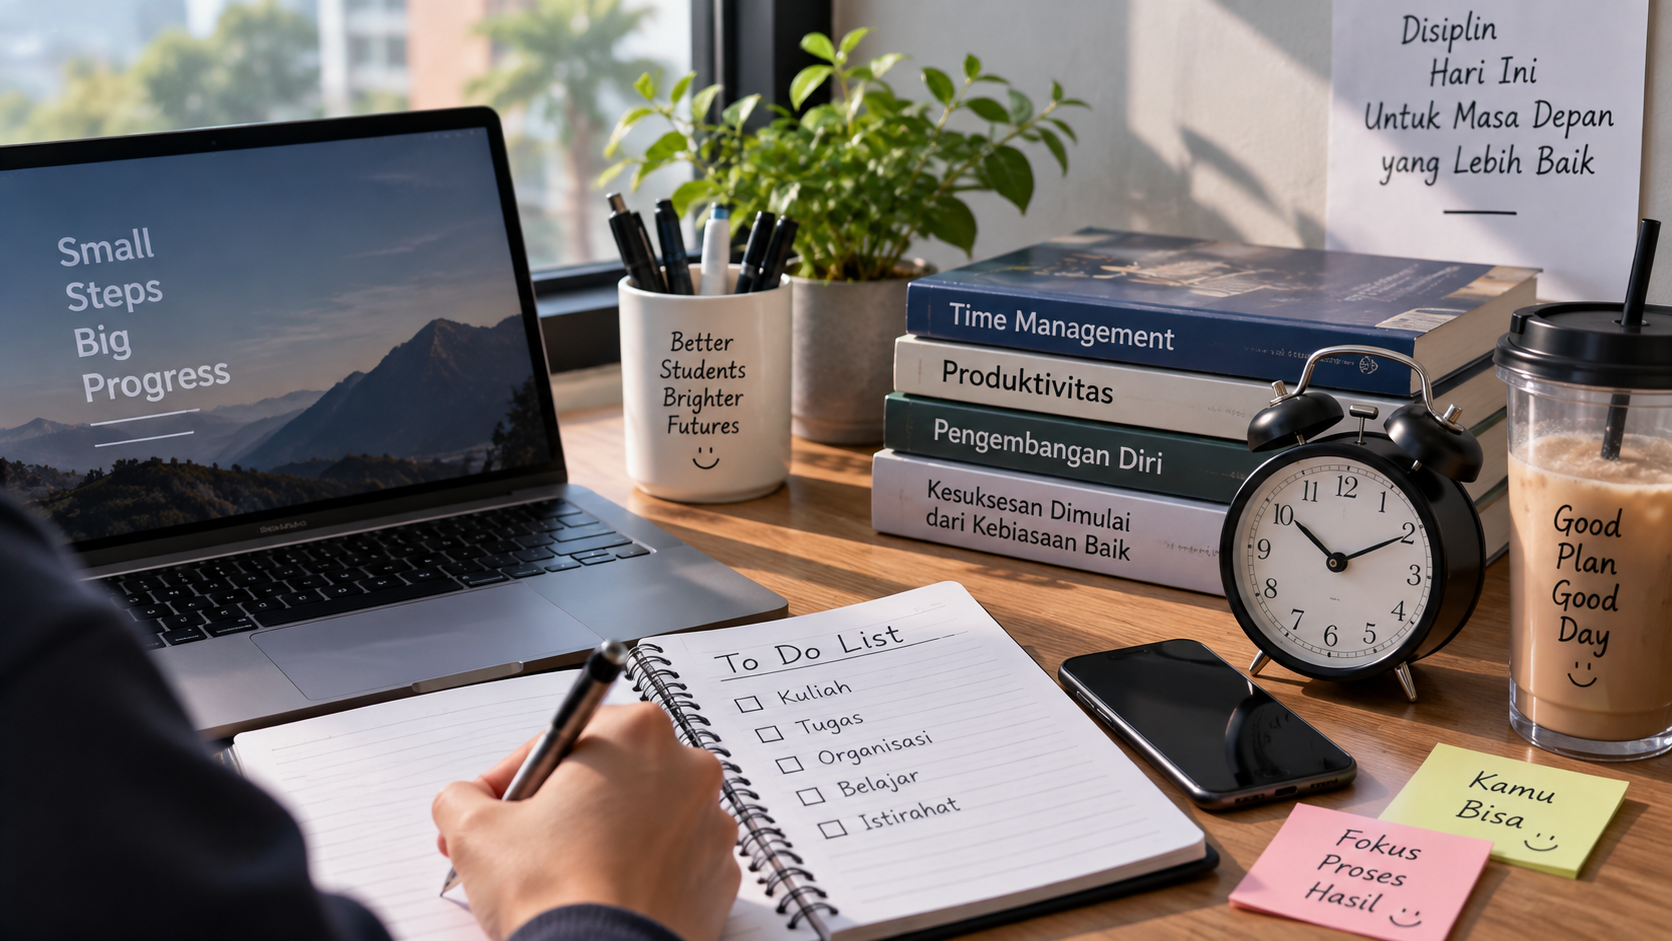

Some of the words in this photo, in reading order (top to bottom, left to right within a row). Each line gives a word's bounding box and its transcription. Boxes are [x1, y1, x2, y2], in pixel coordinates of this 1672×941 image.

[1401, 10, 1498, 53] Disiplin
[1430, 57, 1485, 87] Hari
[1498, 56, 1538, 84] Ini
[1364, 100, 1441, 130] Untuk
[1453, 100, 1520, 129] Masa
[1532, 100, 1615, 139] Depan
[1379, 155, 1440, 186] yang
[1453, 144, 1522, 175] Lebih
[1536, 144, 1595, 175] Baik
[57, 227, 155, 268] Small
[65, 279, 164, 313] Steps
[73, 324, 132, 361] Big
[670, 331, 734, 352] Better
[949, 302, 1007, 331] Time
[1014, 309, 1175, 351] Management
[82, 362, 231, 403] Progress
[659, 358, 746, 379] Students
[942, 359, 1114, 405] Produktivitas
[663, 386, 744, 415] Brighter
[667, 415, 740, 435] Futures
[934, 418, 1110, 468] Pengembangan
[1118, 446, 1163, 475] Diri
[1302, 480, 1318, 502] 11
[1335, 475, 1358, 499] 12
[1378, 491, 1387, 513] 1
[927, 479, 1043, 517] Kesuksesan
[1050, 500, 1131, 533] Dimulai
[1273, 503, 1294, 526] 10
[1554, 504, 1623, 538] Good
[926, 507, 965, 532] dari
[972, 514, 1077, 552] Kebiasaan
[1084, 535, 1131, 562] Baik
[1257, 538, 1271, 560] 9
[1400, 522, 1416, 545] 2
[1556, 542, 1617, 575] Plan
[1264, 578, 1278, 599] 8
[1406, 564, 1422, 586] 3
[1390, 600, 1406, 622] 4
[1552, 579, 1620, 612] Good
[1290, 608, 1305, 630] 7
[1362, 622, 1377, 644] 5
[714, 652, 759, 673] To
[774, 644, 821, 666] Do
[837, 625, 904, 654] List
[1323, 624, 1338, 647] 6
[1558, 616, 1610, 658] Day
[777, 680, 852, 705] Kuliah
[795, 713, 864, 735] Tugas
[818, 730, 933, 765] Organisasi
[837, 770, 919, 797] Belajar
[1468, 770, 1556, 804] Kamu
[858, 797, 961, 831] Istirahat
[1455, 800, 1525, 829] Bisa
[1336, 828, 1421, 862] Fokus
[1317, 854, 1407, 888] Proses
[1304, 881, 1383, 913] Hasil
